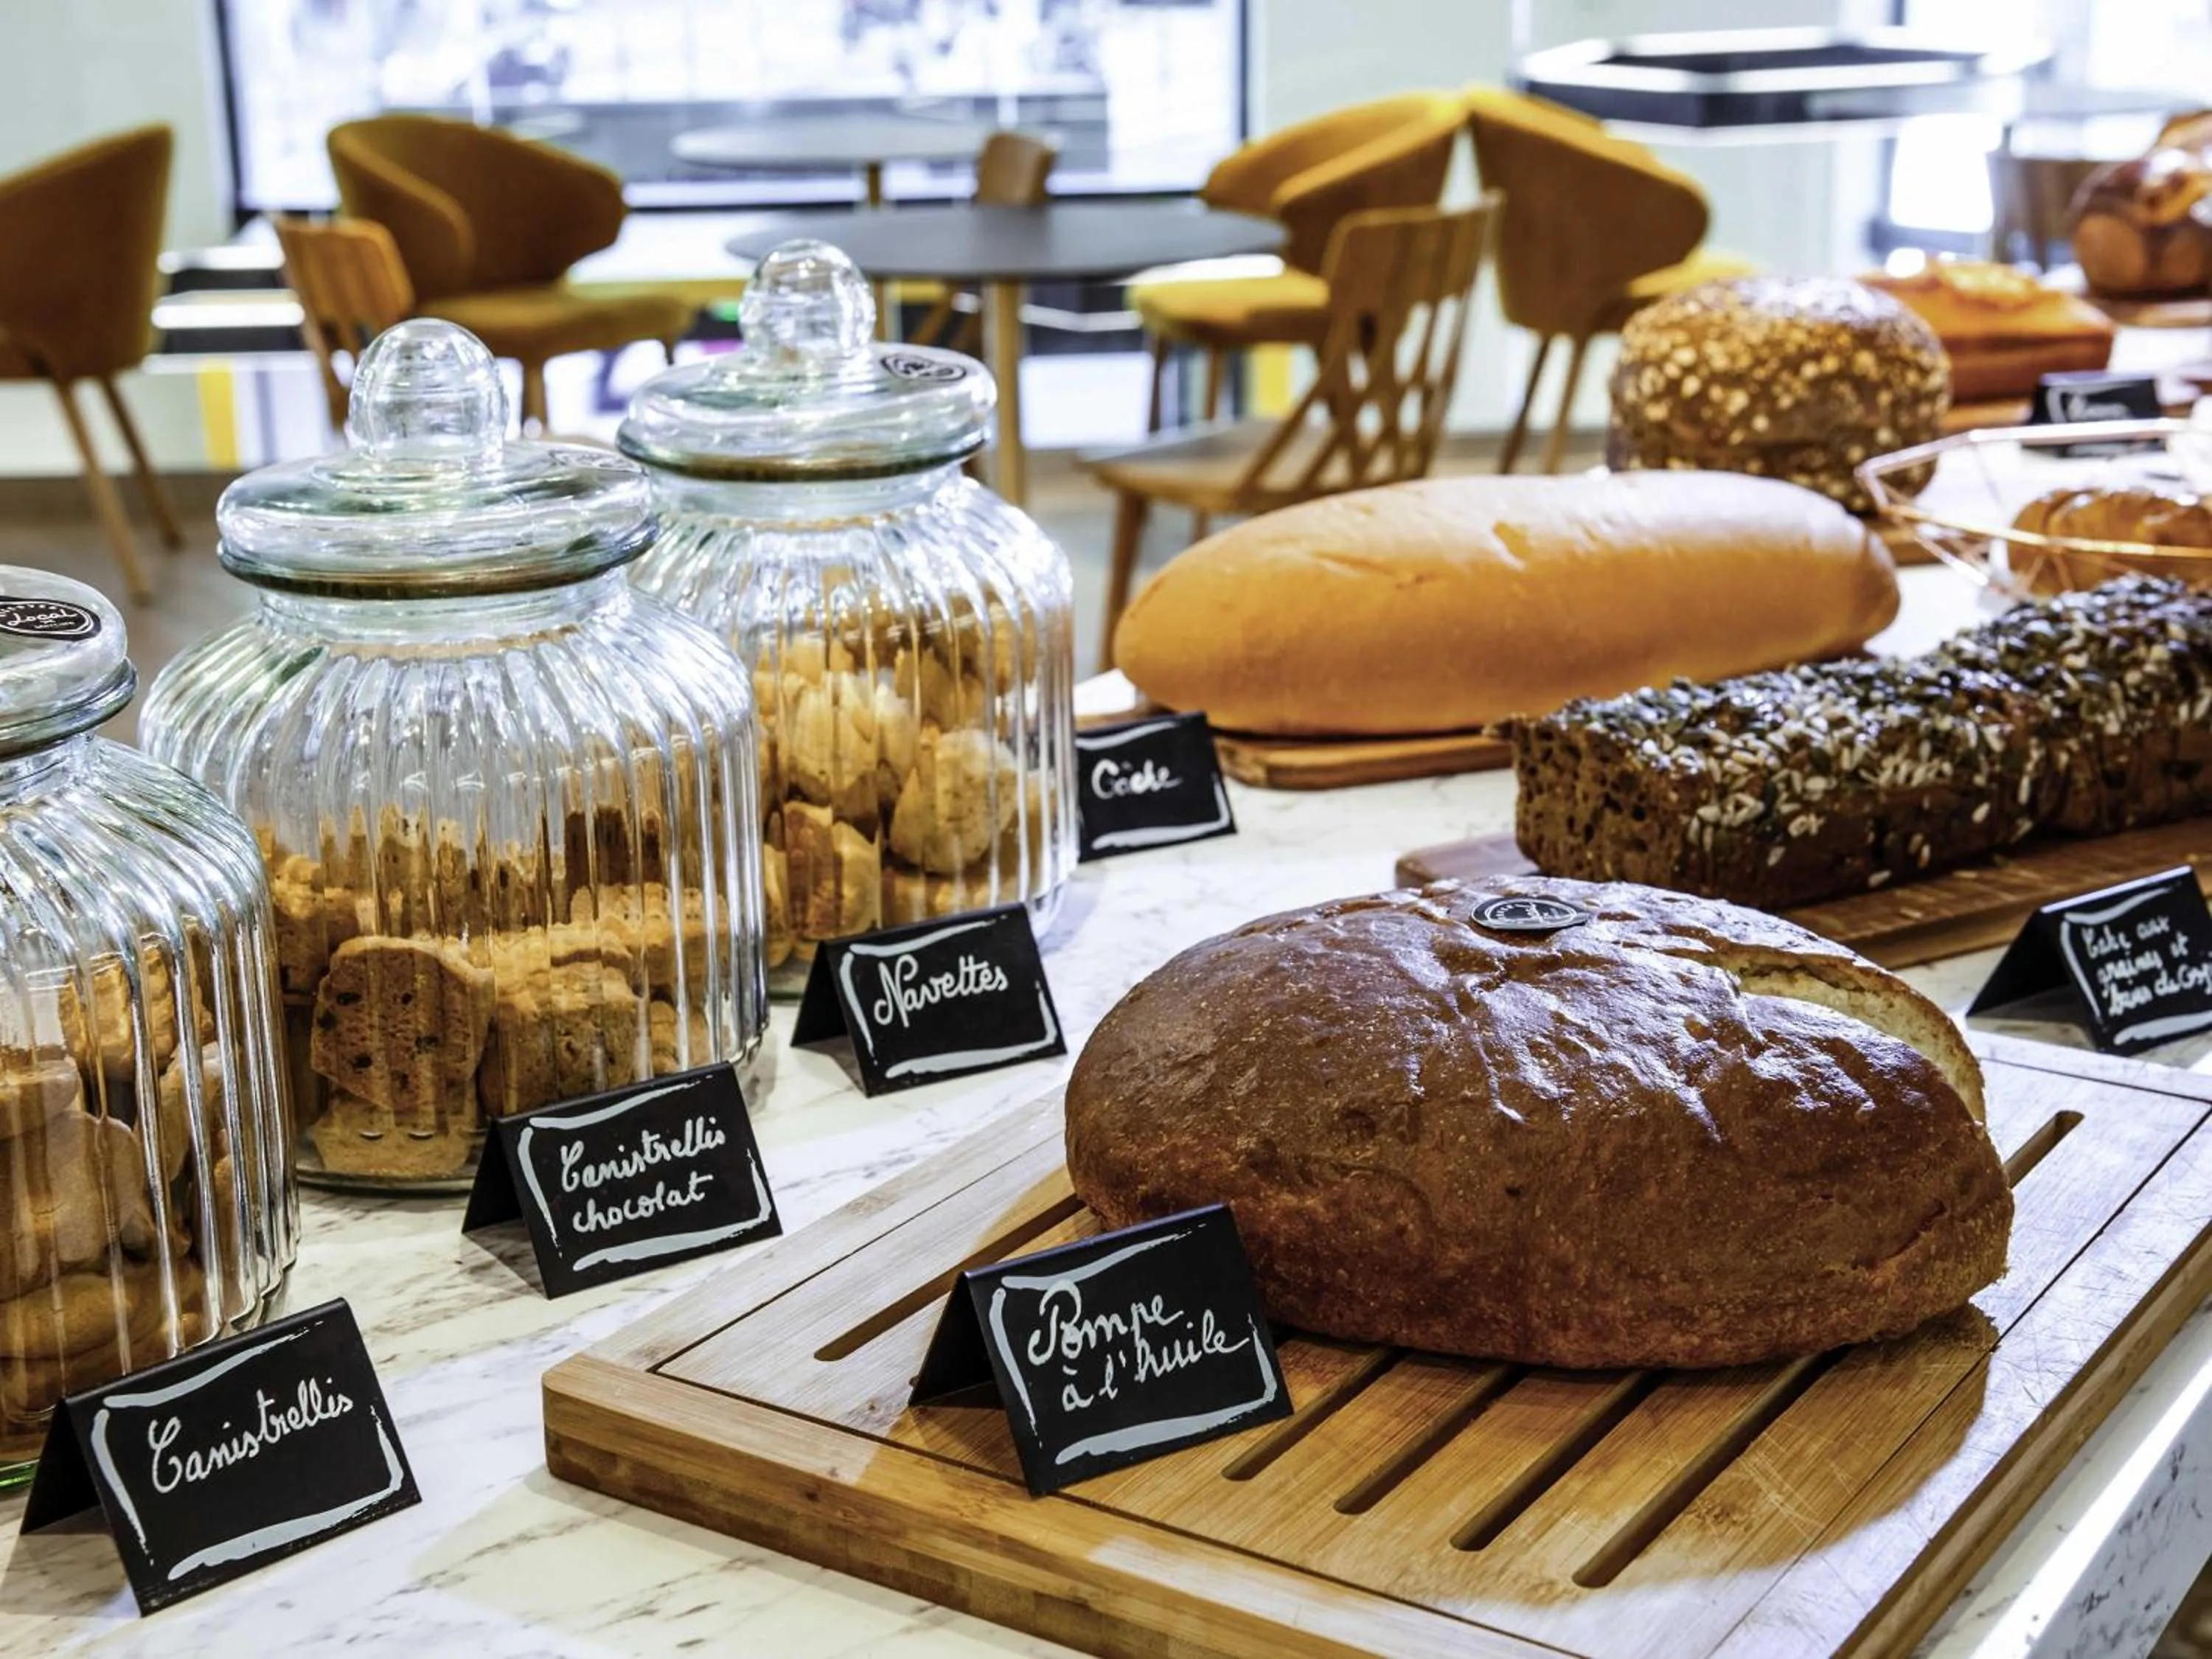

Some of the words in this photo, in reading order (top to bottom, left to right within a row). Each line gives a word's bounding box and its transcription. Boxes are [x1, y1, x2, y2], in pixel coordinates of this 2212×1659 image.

[874, 954, 1009, 1028] Navettes
[572, 1171, 714, 1233] chocolat
[1028, 1279, 1184, 1366] Pompe
[1062, 1365, 1095, 1411] à
[1099, 1310, 1250, 1400] l'huile
[148, 1377, 354, 1494] Canistrellis
